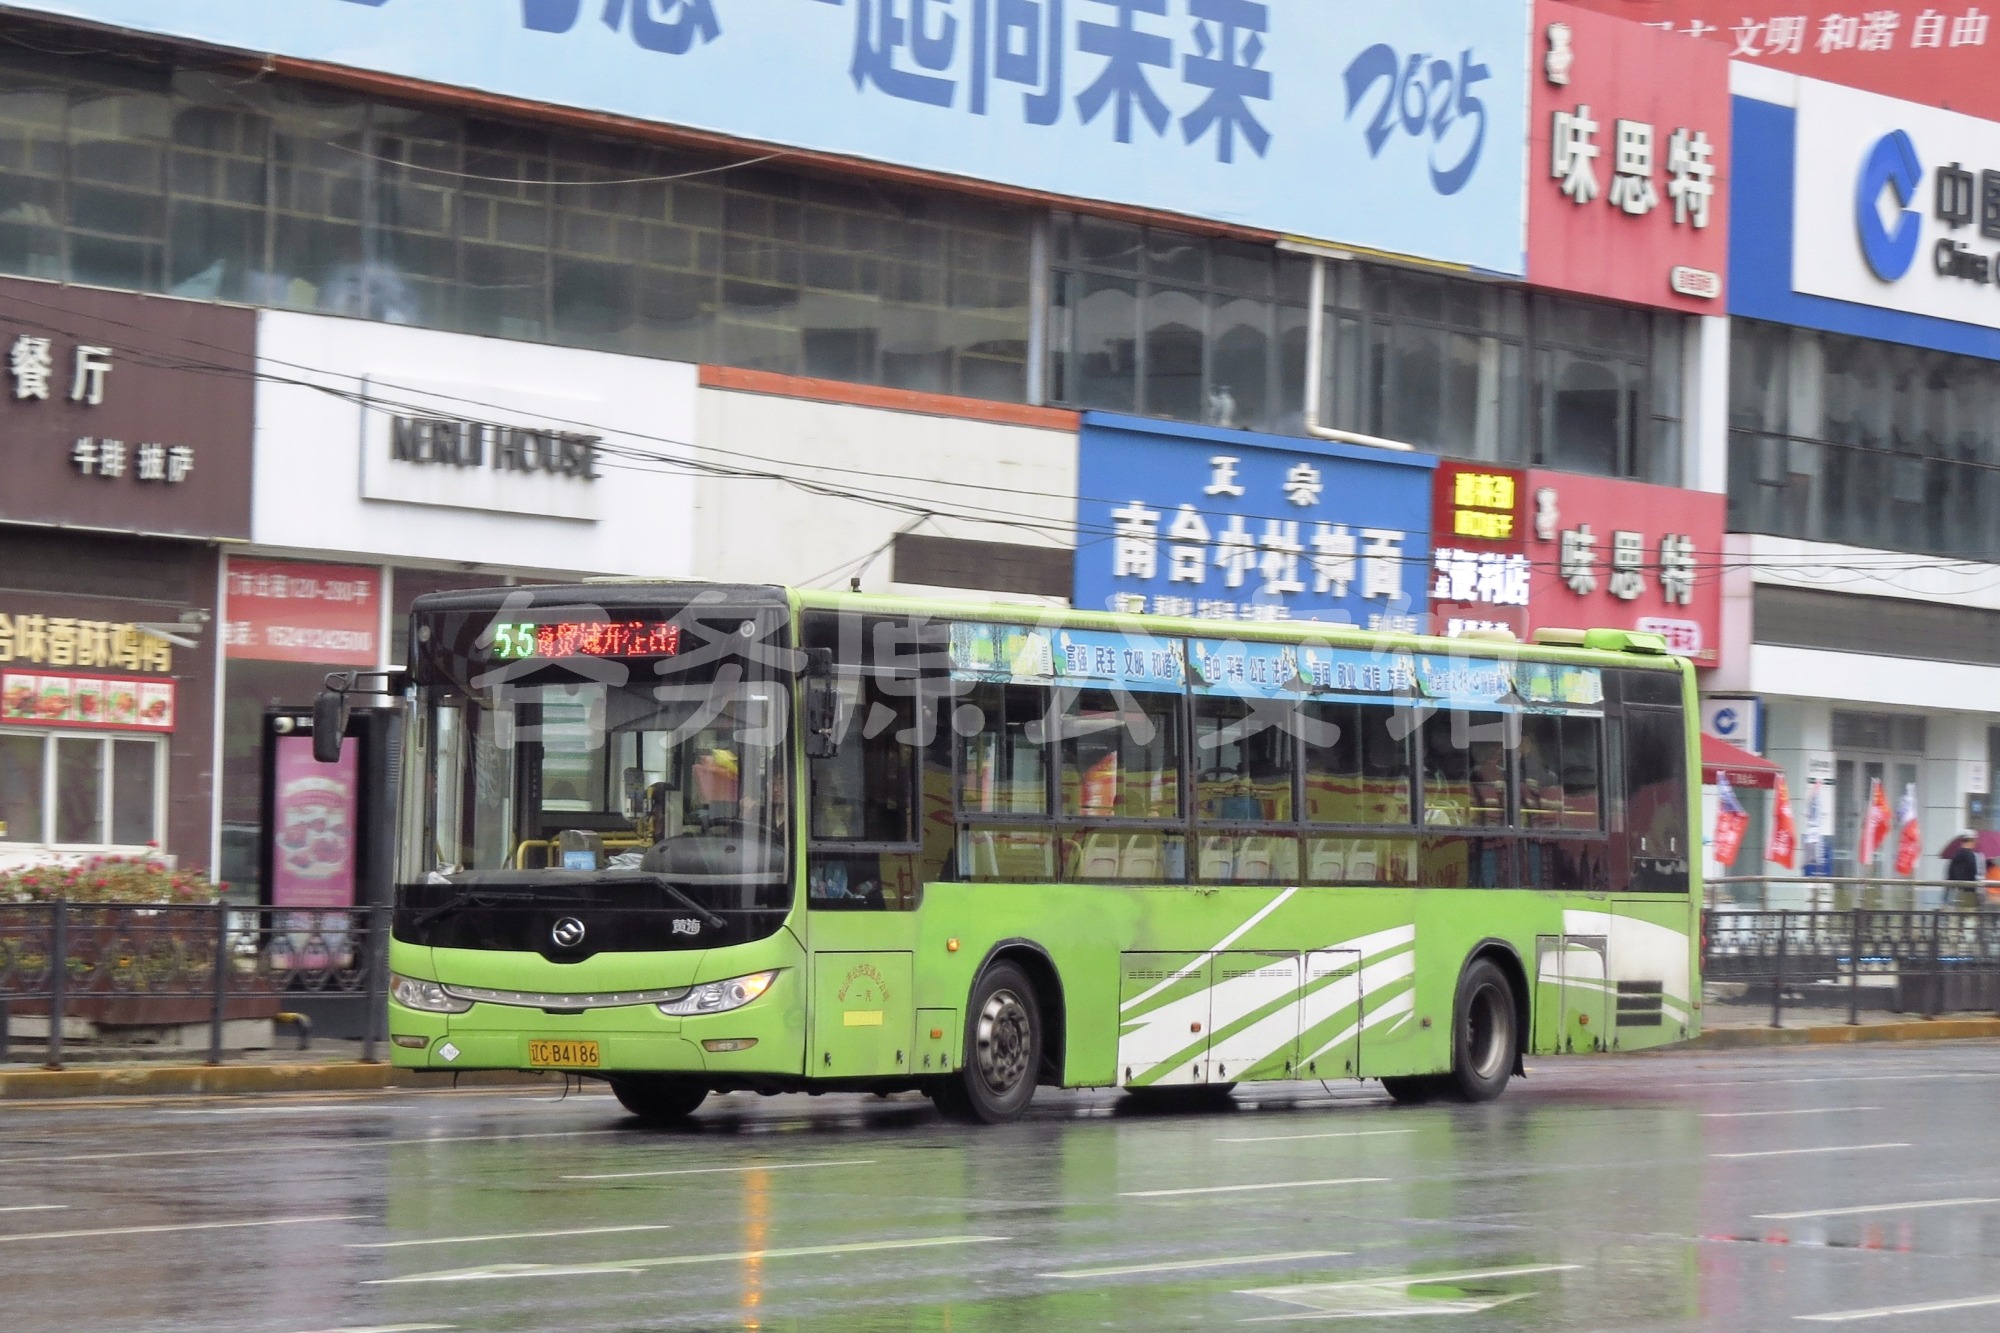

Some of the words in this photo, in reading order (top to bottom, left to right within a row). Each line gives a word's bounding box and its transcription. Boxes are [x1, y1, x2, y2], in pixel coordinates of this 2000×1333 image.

[1729, 17, 1808, 57] 文明
[1814, 11, 1900, 54] 和谐
[1911, 8, 1990, 48] 自由
[812, 0, 1275, 164] 起向未来
[1551, 104, 1716, 228] 味思特
[11, 334, 113, 405] 餐厅
[74, 436, 127, 477] 牛排
[138, 442, 195, 482] 披萨
[493, 425, 603, 479] HOUSE
[1203, 456, 1324, 506] 正宗
[1561, 524, 1698, 605] 味思特
[494, 622, 535, 657] 55
[1066, 645, 1088, 672] 富强
[1096, 648, 1117, 675] 民主
[1124, 650, 1146, 677] 文明
[1151, 652, 1173, 679] 和谐
[1204, 655, 1221, 681] 自由
[1227, 656, 1244, 682] 平等
[1250, 657, 1267, 684] 公正
[1362, 664, 1381, 690] 诚信
